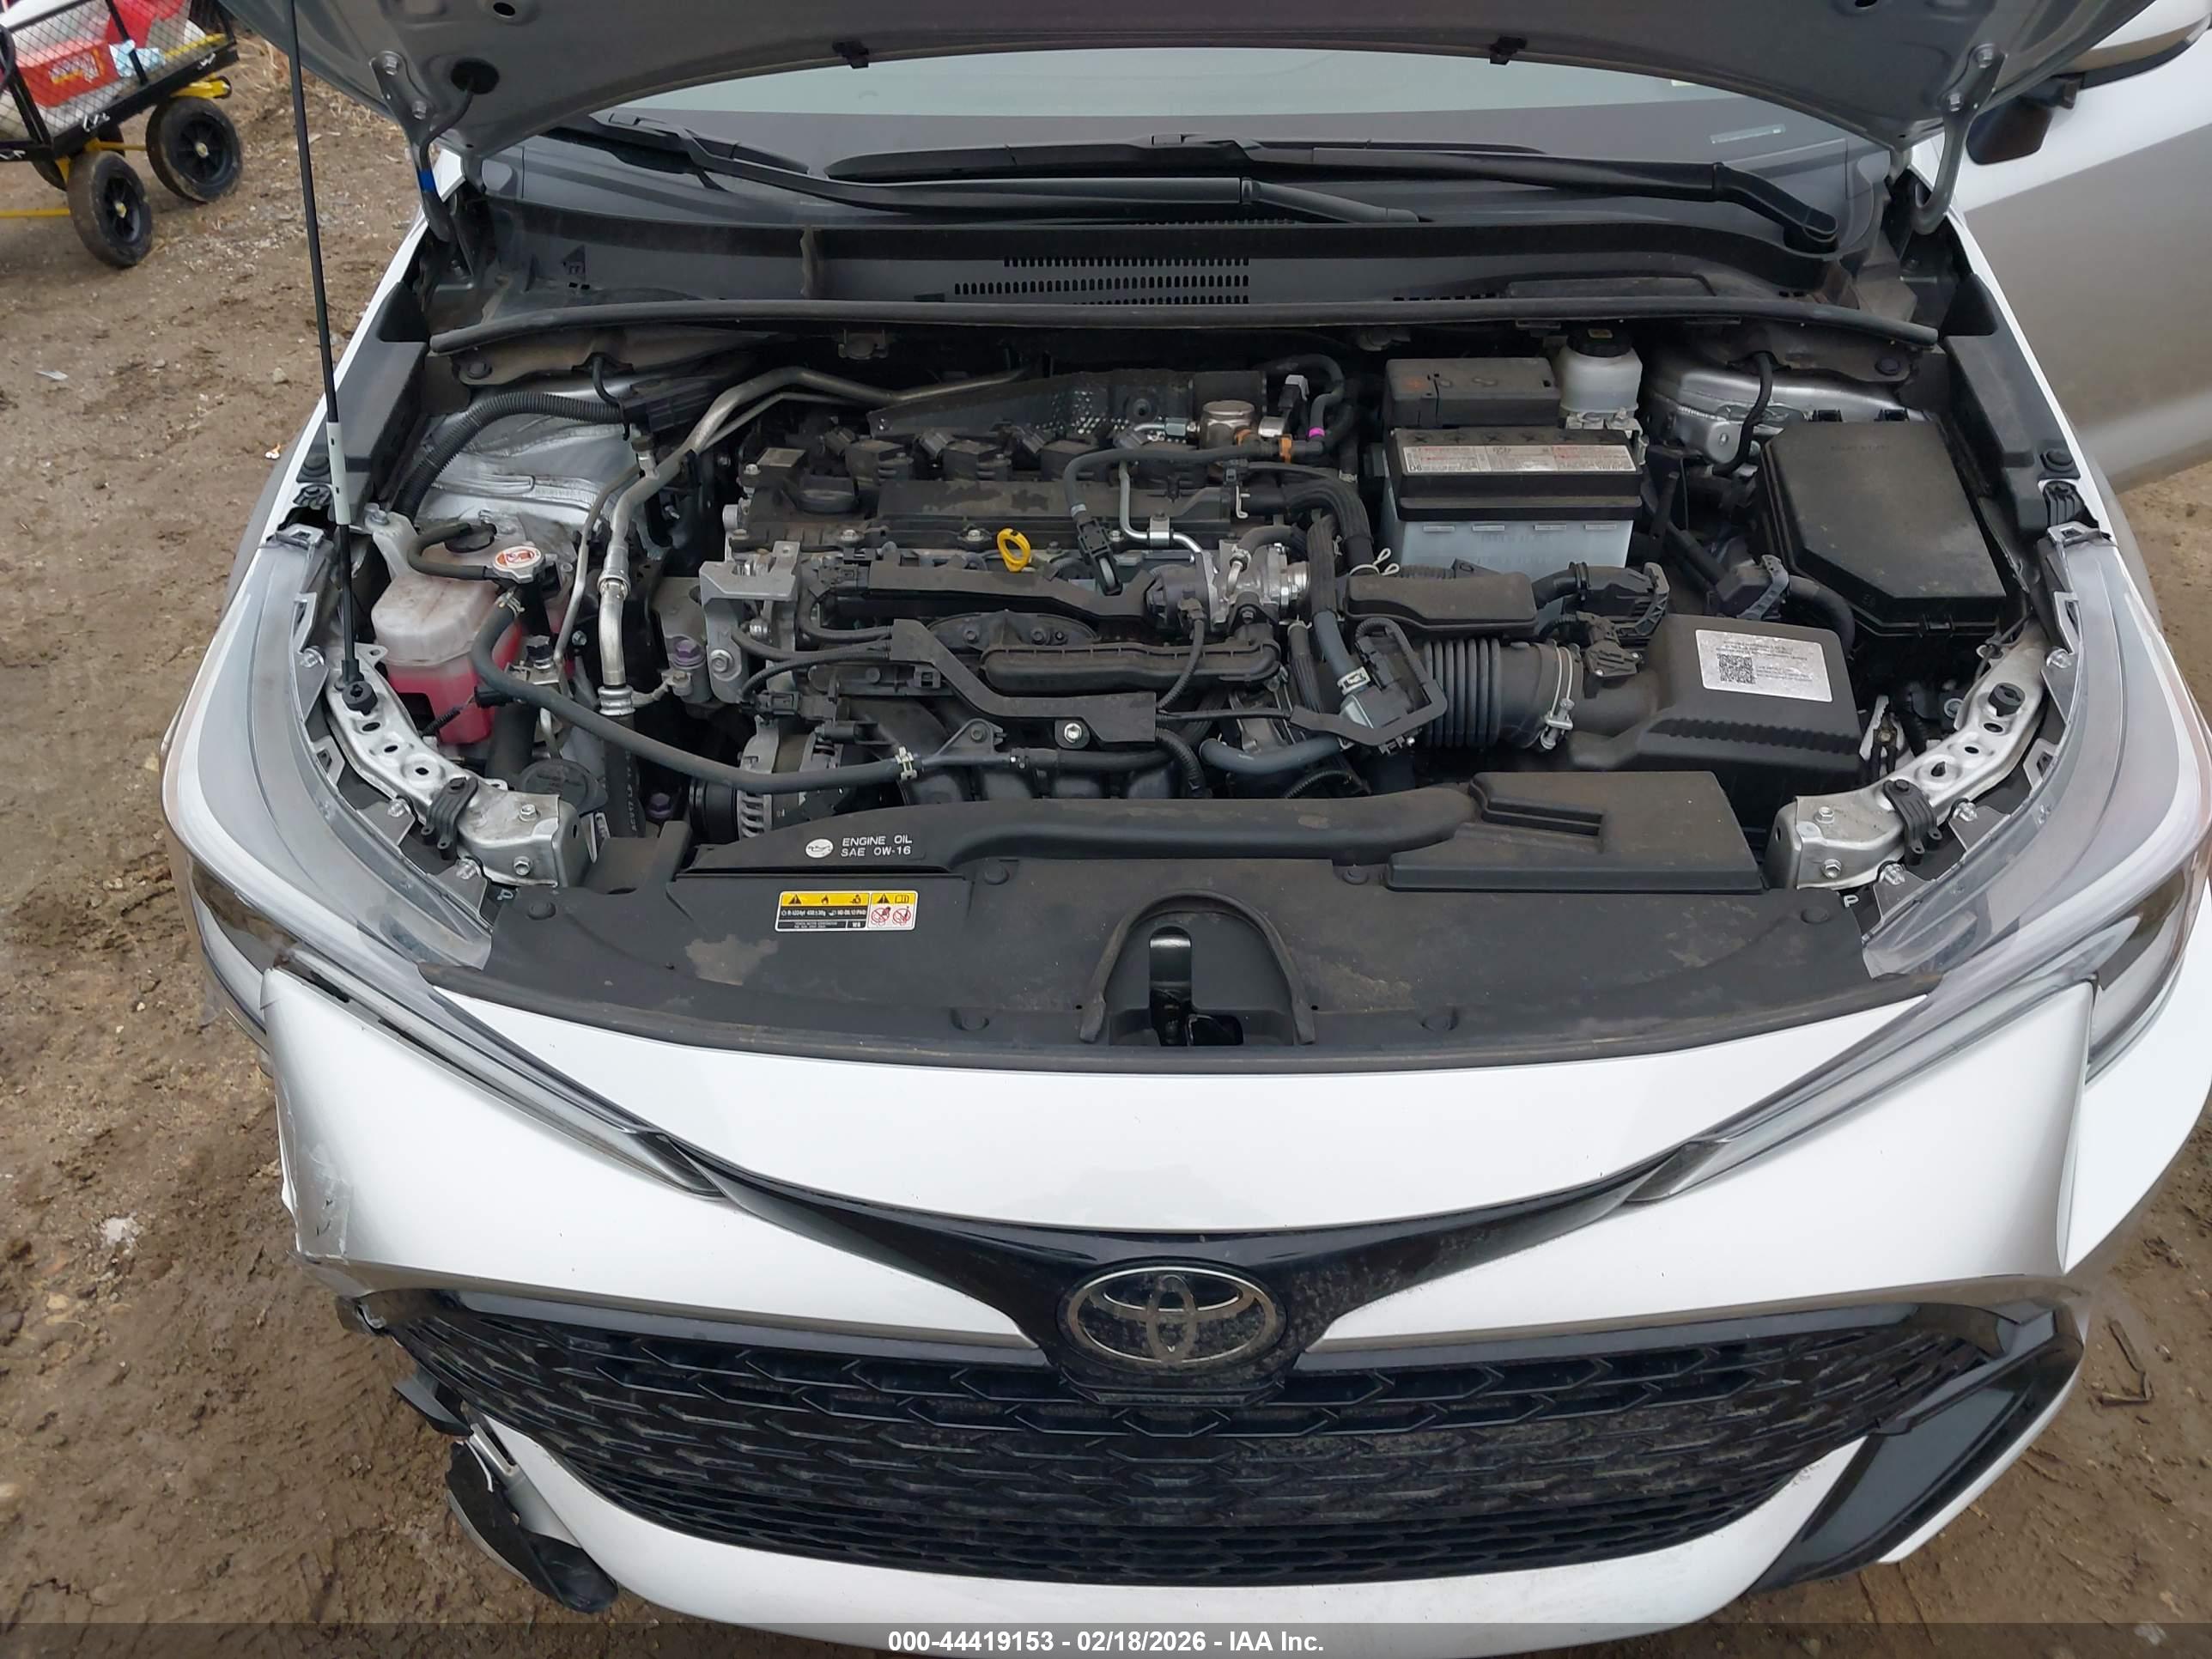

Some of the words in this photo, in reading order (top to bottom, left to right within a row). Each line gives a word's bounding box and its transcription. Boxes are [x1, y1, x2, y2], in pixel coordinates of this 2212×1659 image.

[842, 836, 886, 847] ENGINE
[894, 835, 913, 844] OIL
[841, 847, 866, 857] SAE
[873, 845, 911, 856] 0W-16
